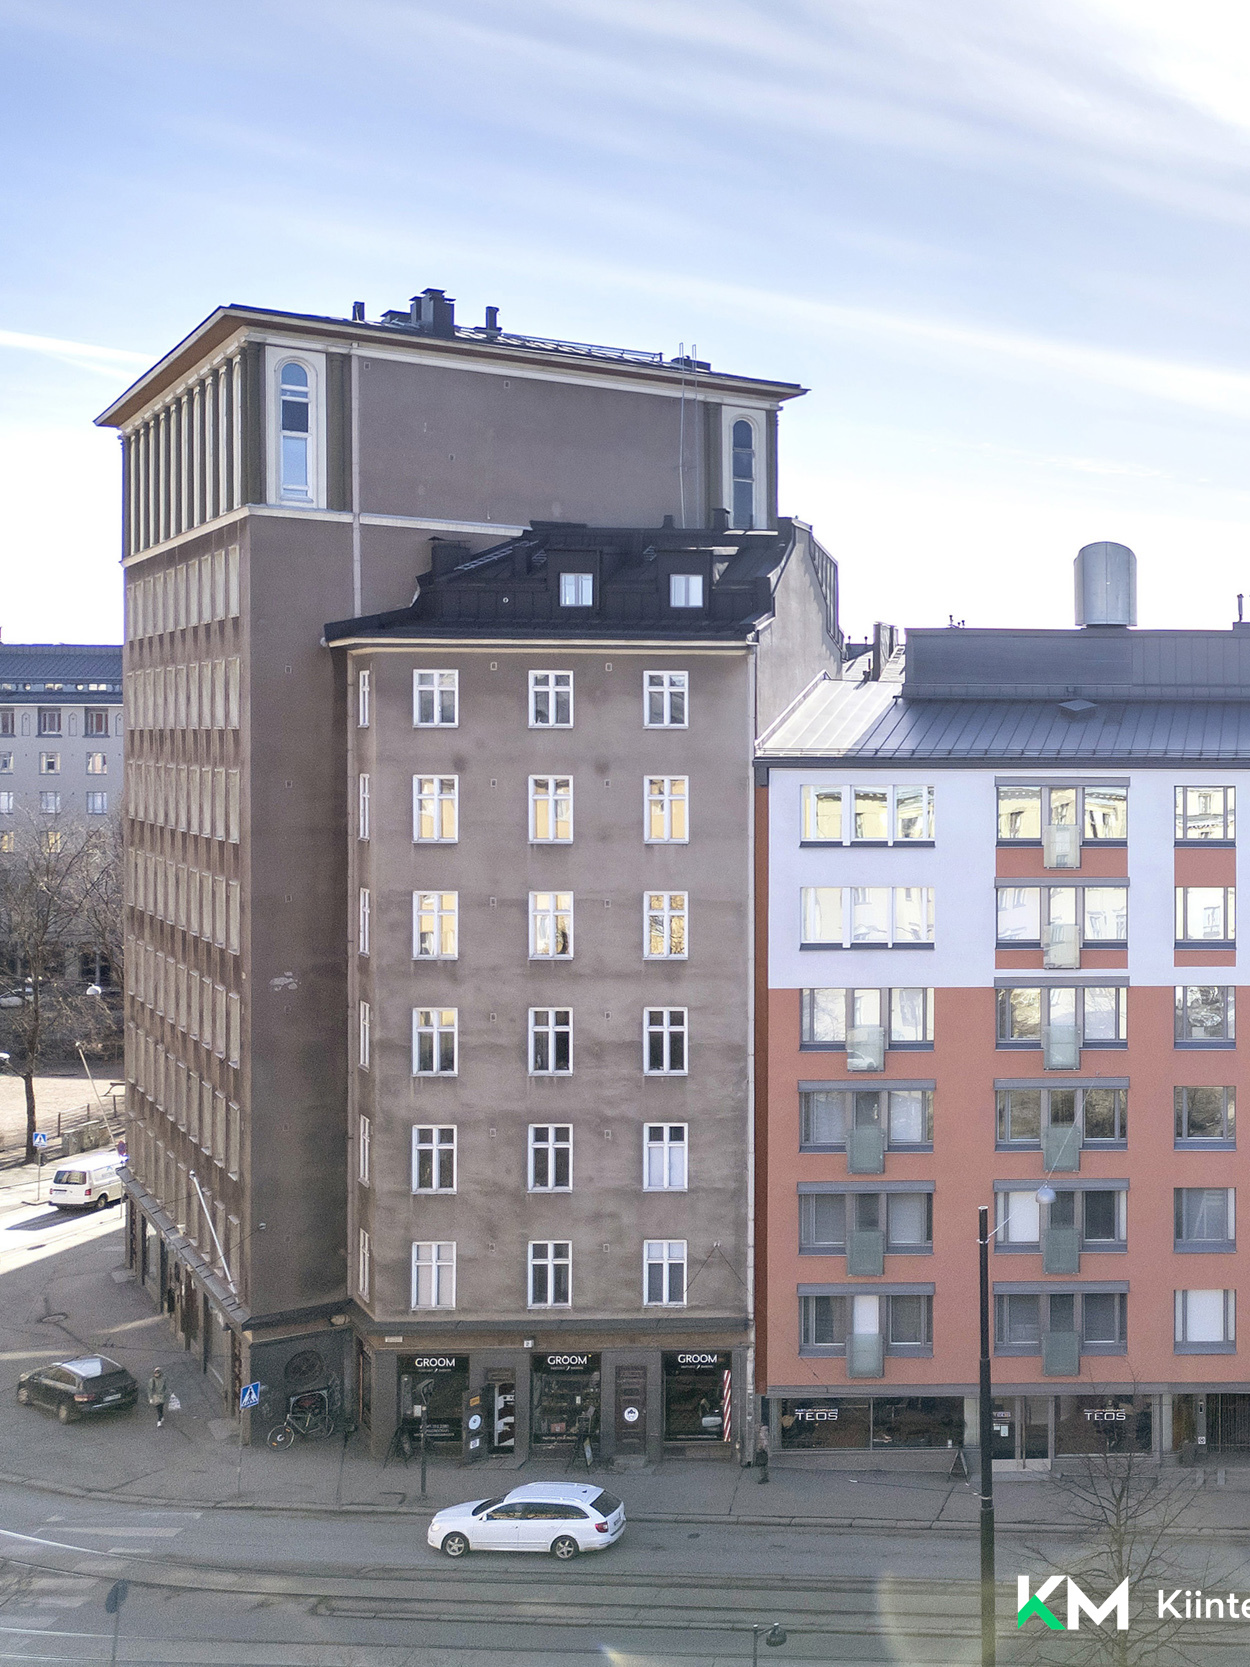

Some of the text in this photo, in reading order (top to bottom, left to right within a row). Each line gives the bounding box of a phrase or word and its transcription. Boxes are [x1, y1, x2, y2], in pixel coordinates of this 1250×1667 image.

[415, 1357, 456, 1367] GROOM
[547, 1355, 587, 1365] GROOM
[678, 1354, 717, 1363] GROOM
[795, 1412, 838, 1421] TEOS
[1084, 1412, 1126, 1421] TEOS
